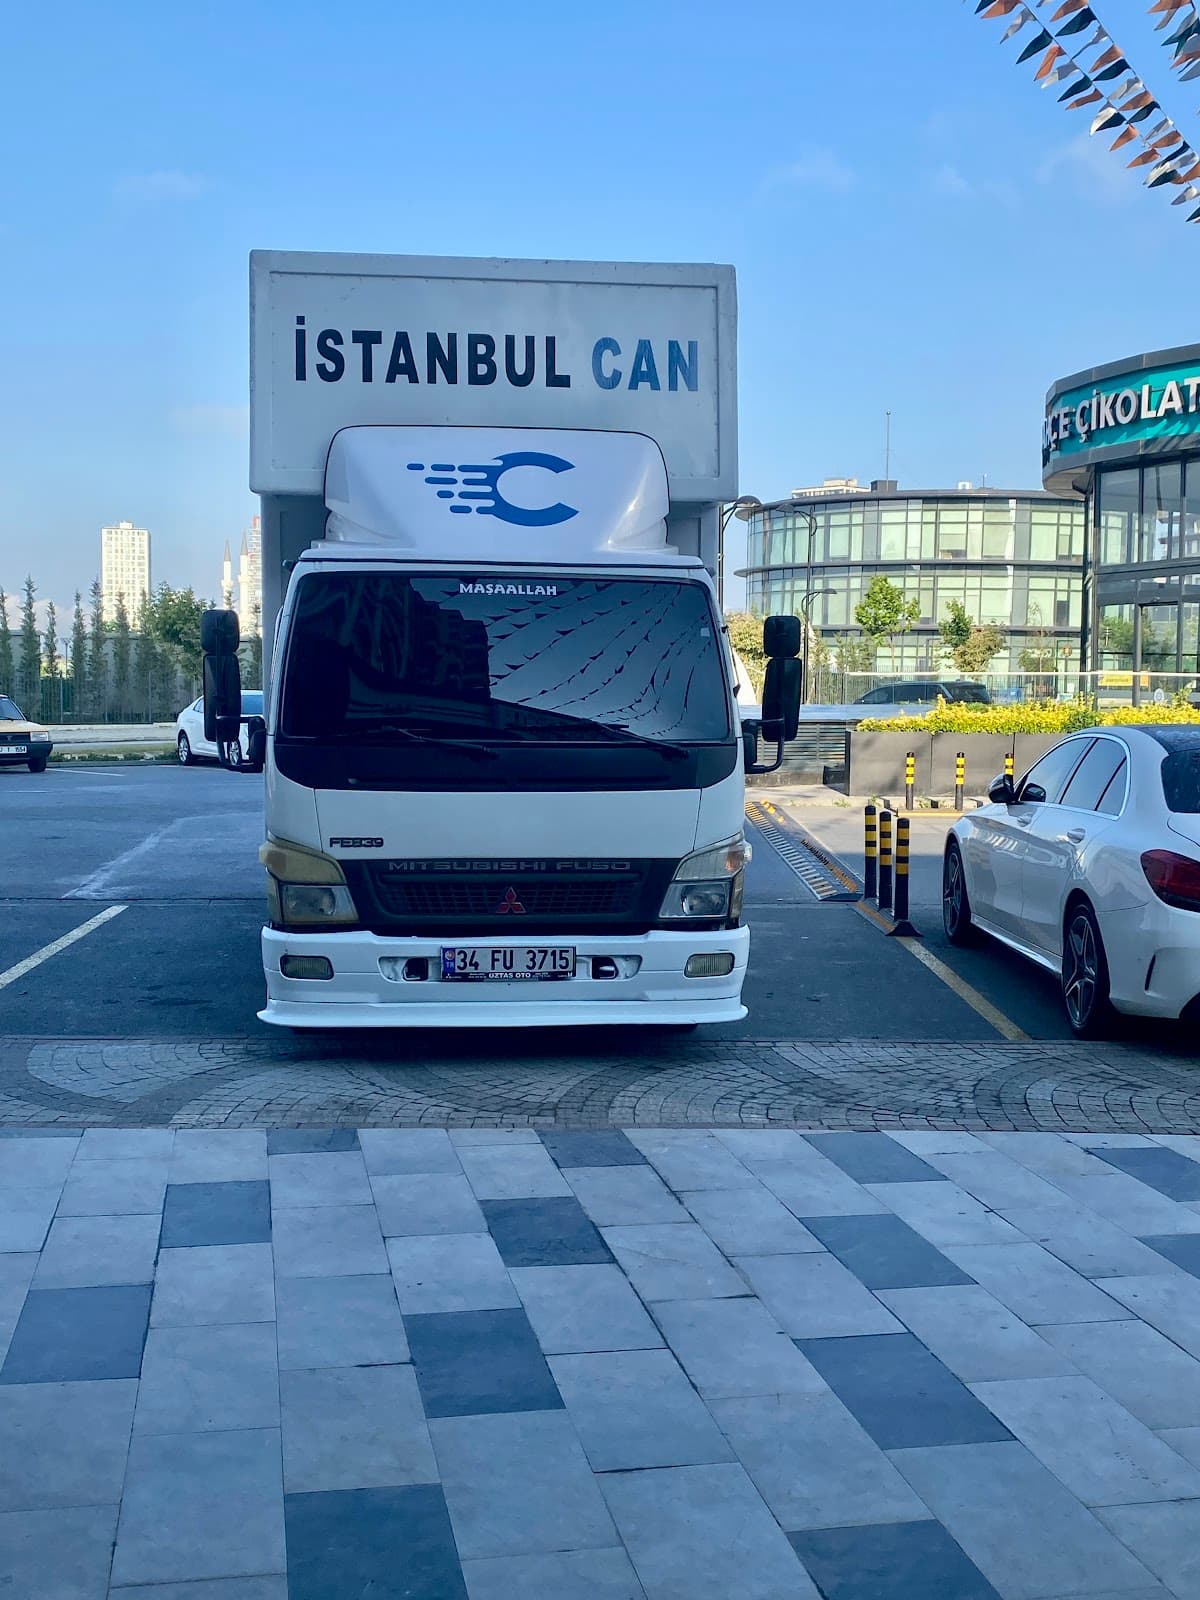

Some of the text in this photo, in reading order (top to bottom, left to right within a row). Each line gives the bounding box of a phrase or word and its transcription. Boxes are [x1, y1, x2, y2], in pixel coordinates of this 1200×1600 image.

[295, 315, 699, 392] İSTANBUL CAN
[388, 861, 631, 871] MITSUBISHI FUSO
[456, 949, 570, 971] 34 FU 3715
